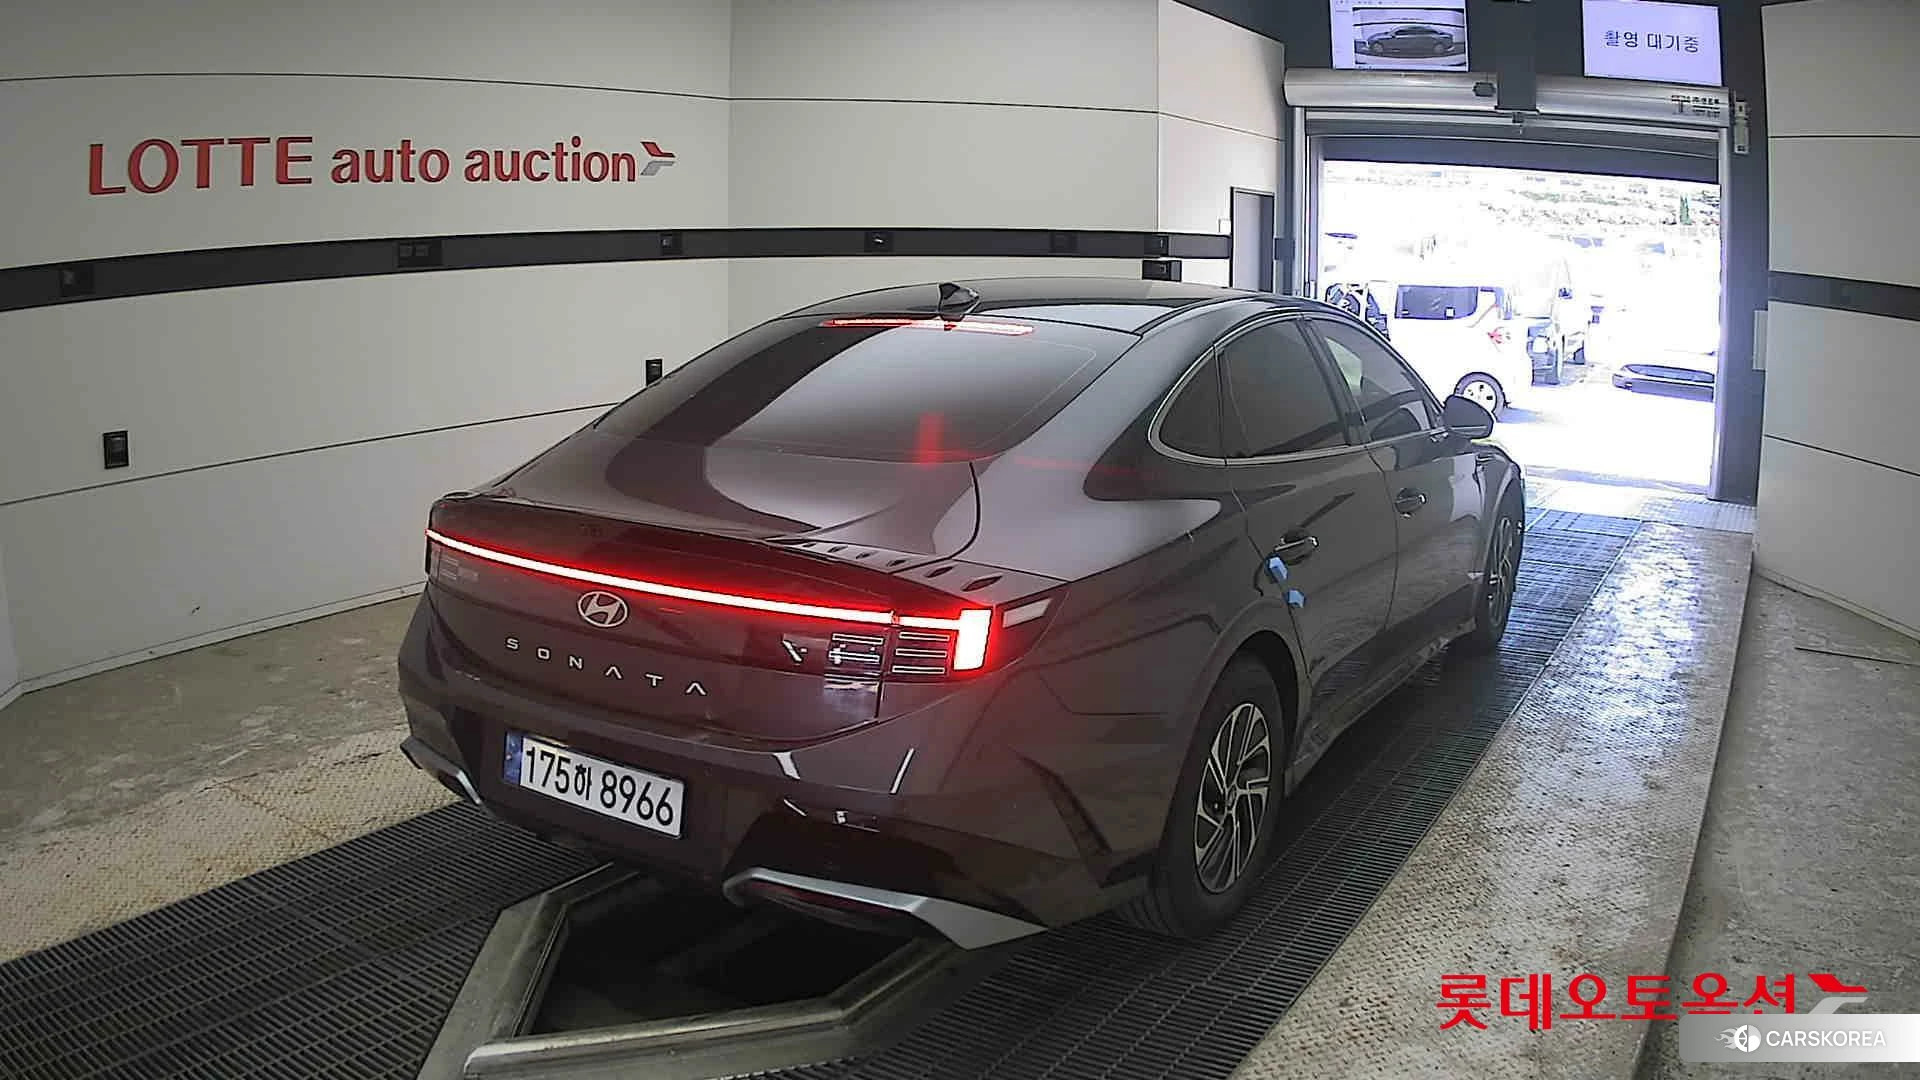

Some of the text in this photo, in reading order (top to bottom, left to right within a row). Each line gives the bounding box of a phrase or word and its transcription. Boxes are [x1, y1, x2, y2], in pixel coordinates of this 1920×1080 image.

[1604, 30, 1699, 53] 촬영 대기중
[89, 135, 637, 195] LOTTE auto auction
[506, 637, 708, 696] SONATA
[526, 746, 674, 827] 175하 8966
